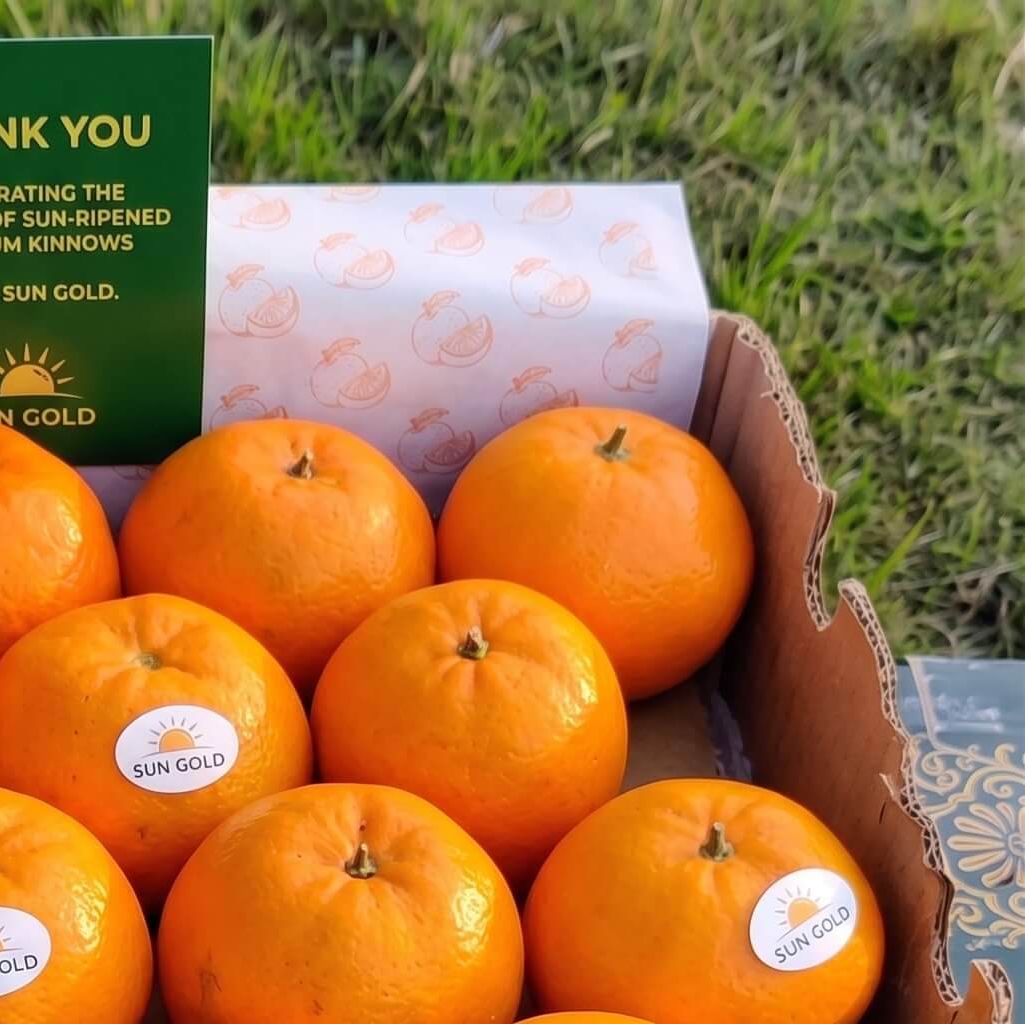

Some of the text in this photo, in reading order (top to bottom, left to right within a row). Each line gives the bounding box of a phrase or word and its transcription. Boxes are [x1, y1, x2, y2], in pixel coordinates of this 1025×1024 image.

[60, 114, 151, 148] YOU
[82, 184, 125, 201] THE
[22, 208, 171, 228] SUN-RIPENED
[28, 234, 134, 253] KINNOWS
[2, 284, 47, 302] SUN
[53, 284, 119, 302] GOLD.
[22, 407, 96, 426] GOLD
[133, 753, 225, 778] SUN GOLD
[774, 906, 850, 964] SUN GOLD
